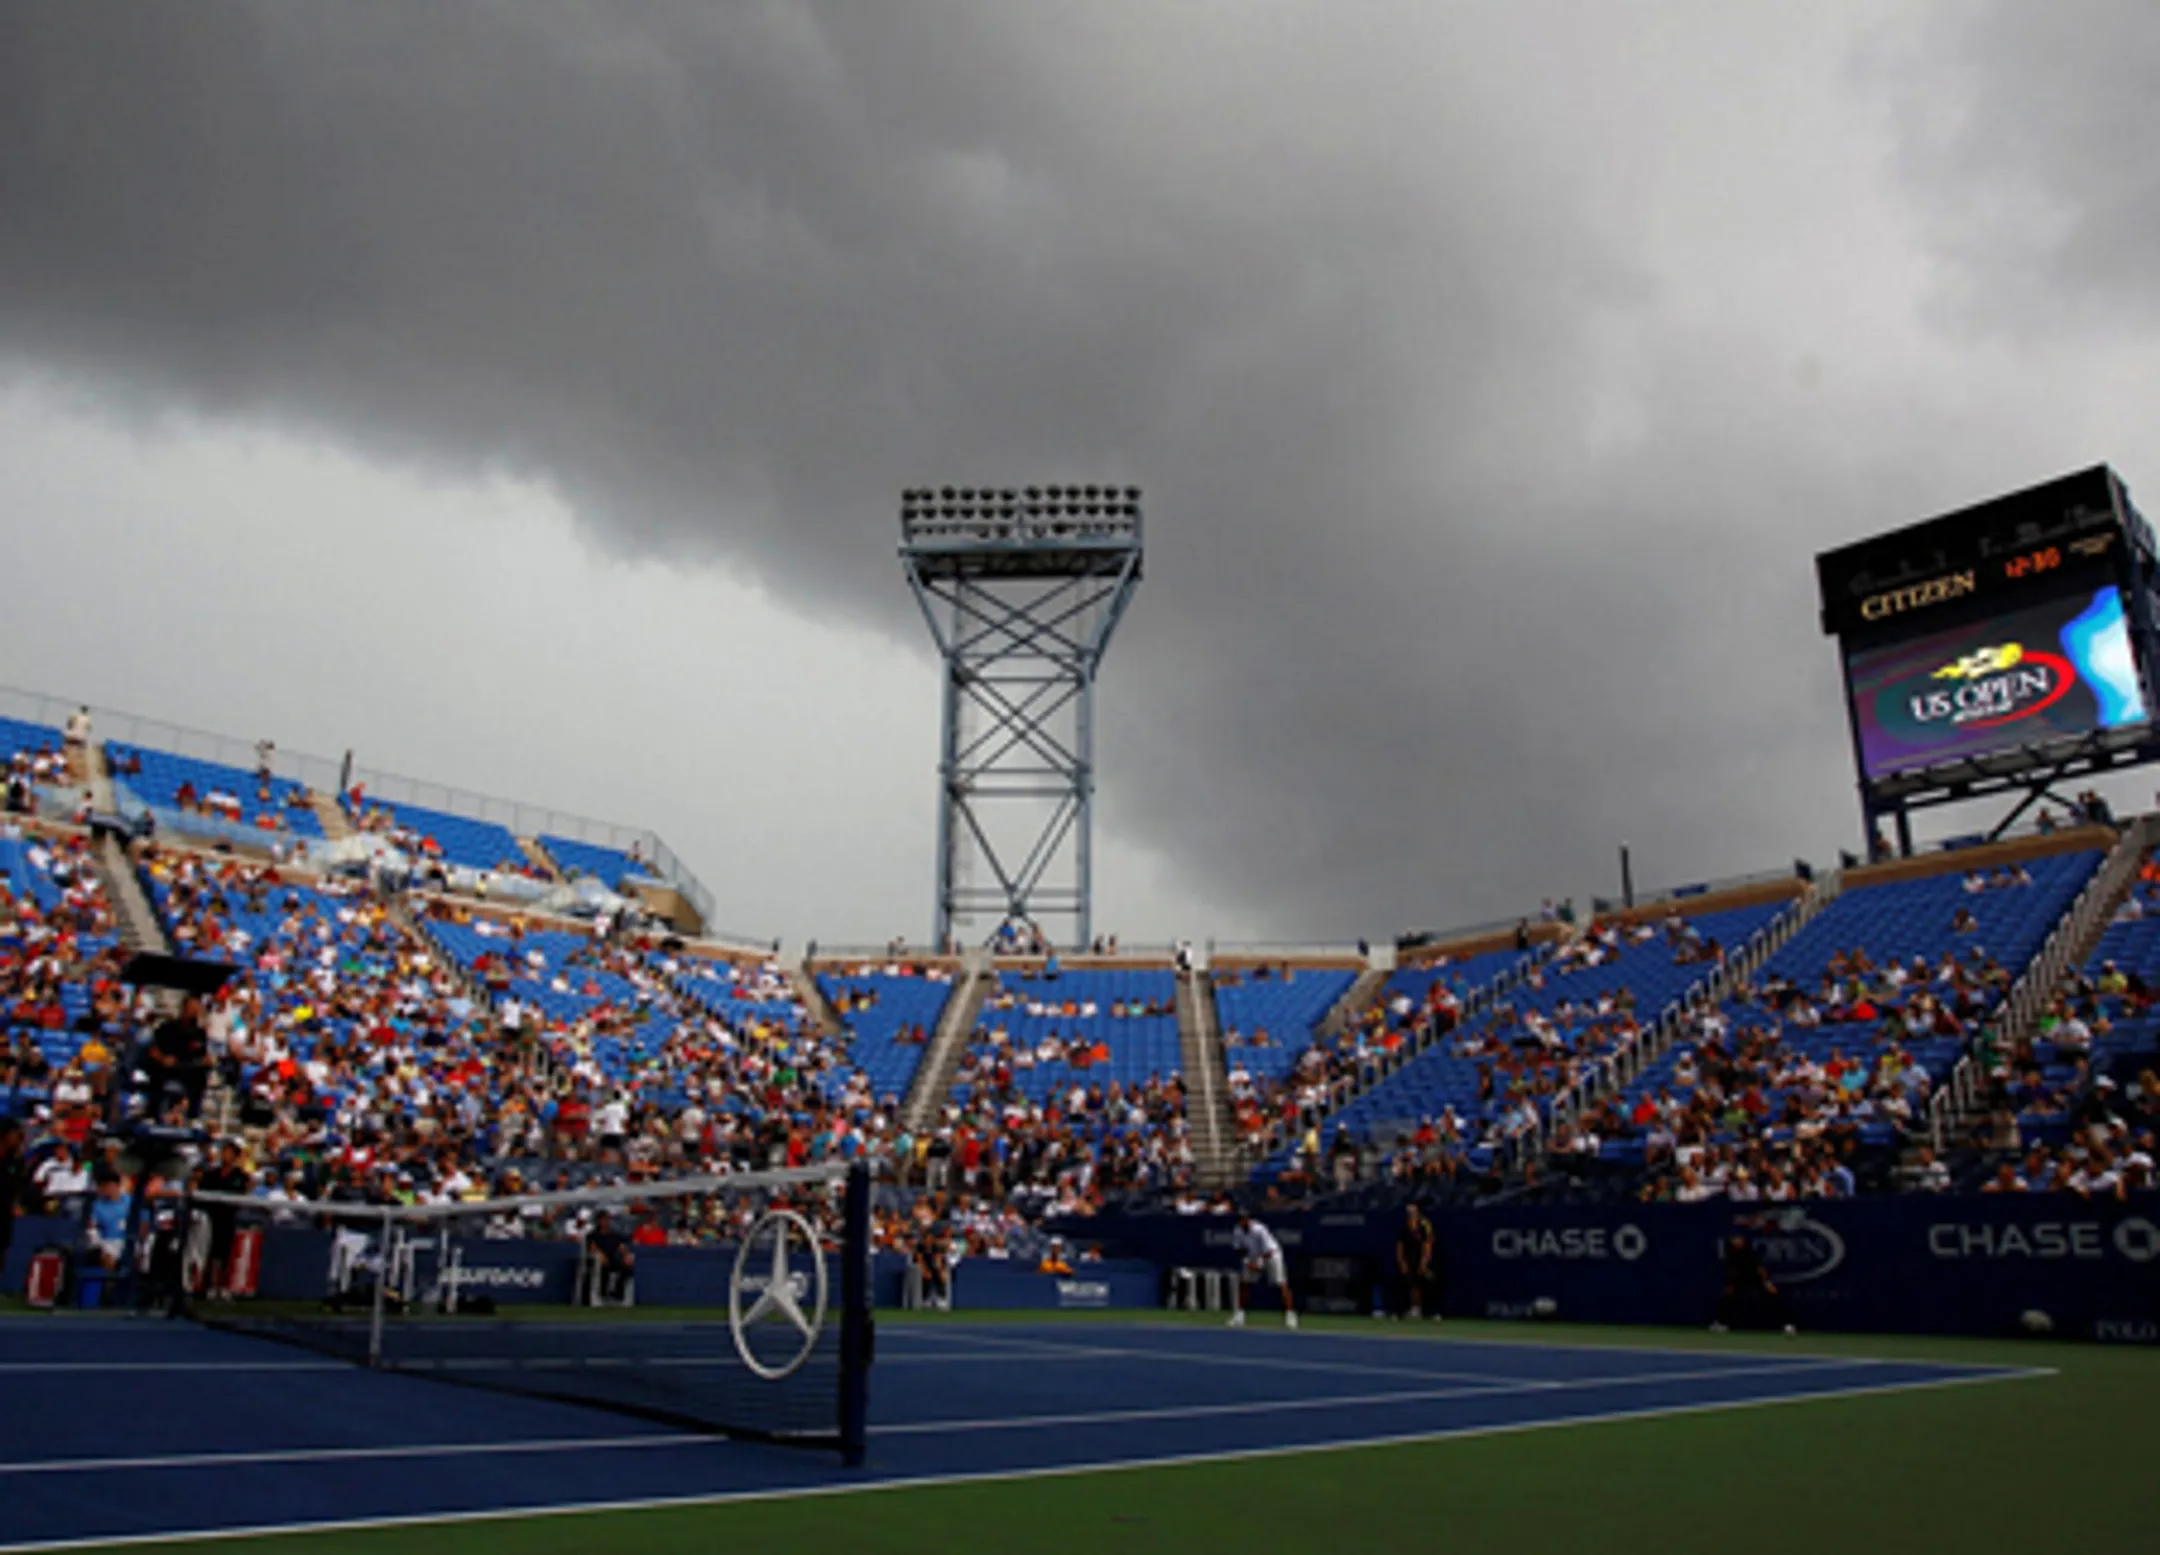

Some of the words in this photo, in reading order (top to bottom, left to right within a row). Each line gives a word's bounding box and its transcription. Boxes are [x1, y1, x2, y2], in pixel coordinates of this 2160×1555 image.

[1860, 569, 1976, 621] CITIZEN
[1909, 690, 1952, 722] US
[1953, 666, 2050, 709] OPEN
[1491, 1227, 1609, 1260] CHASE
[1927, 1222, 2105, 1260] CHASE
